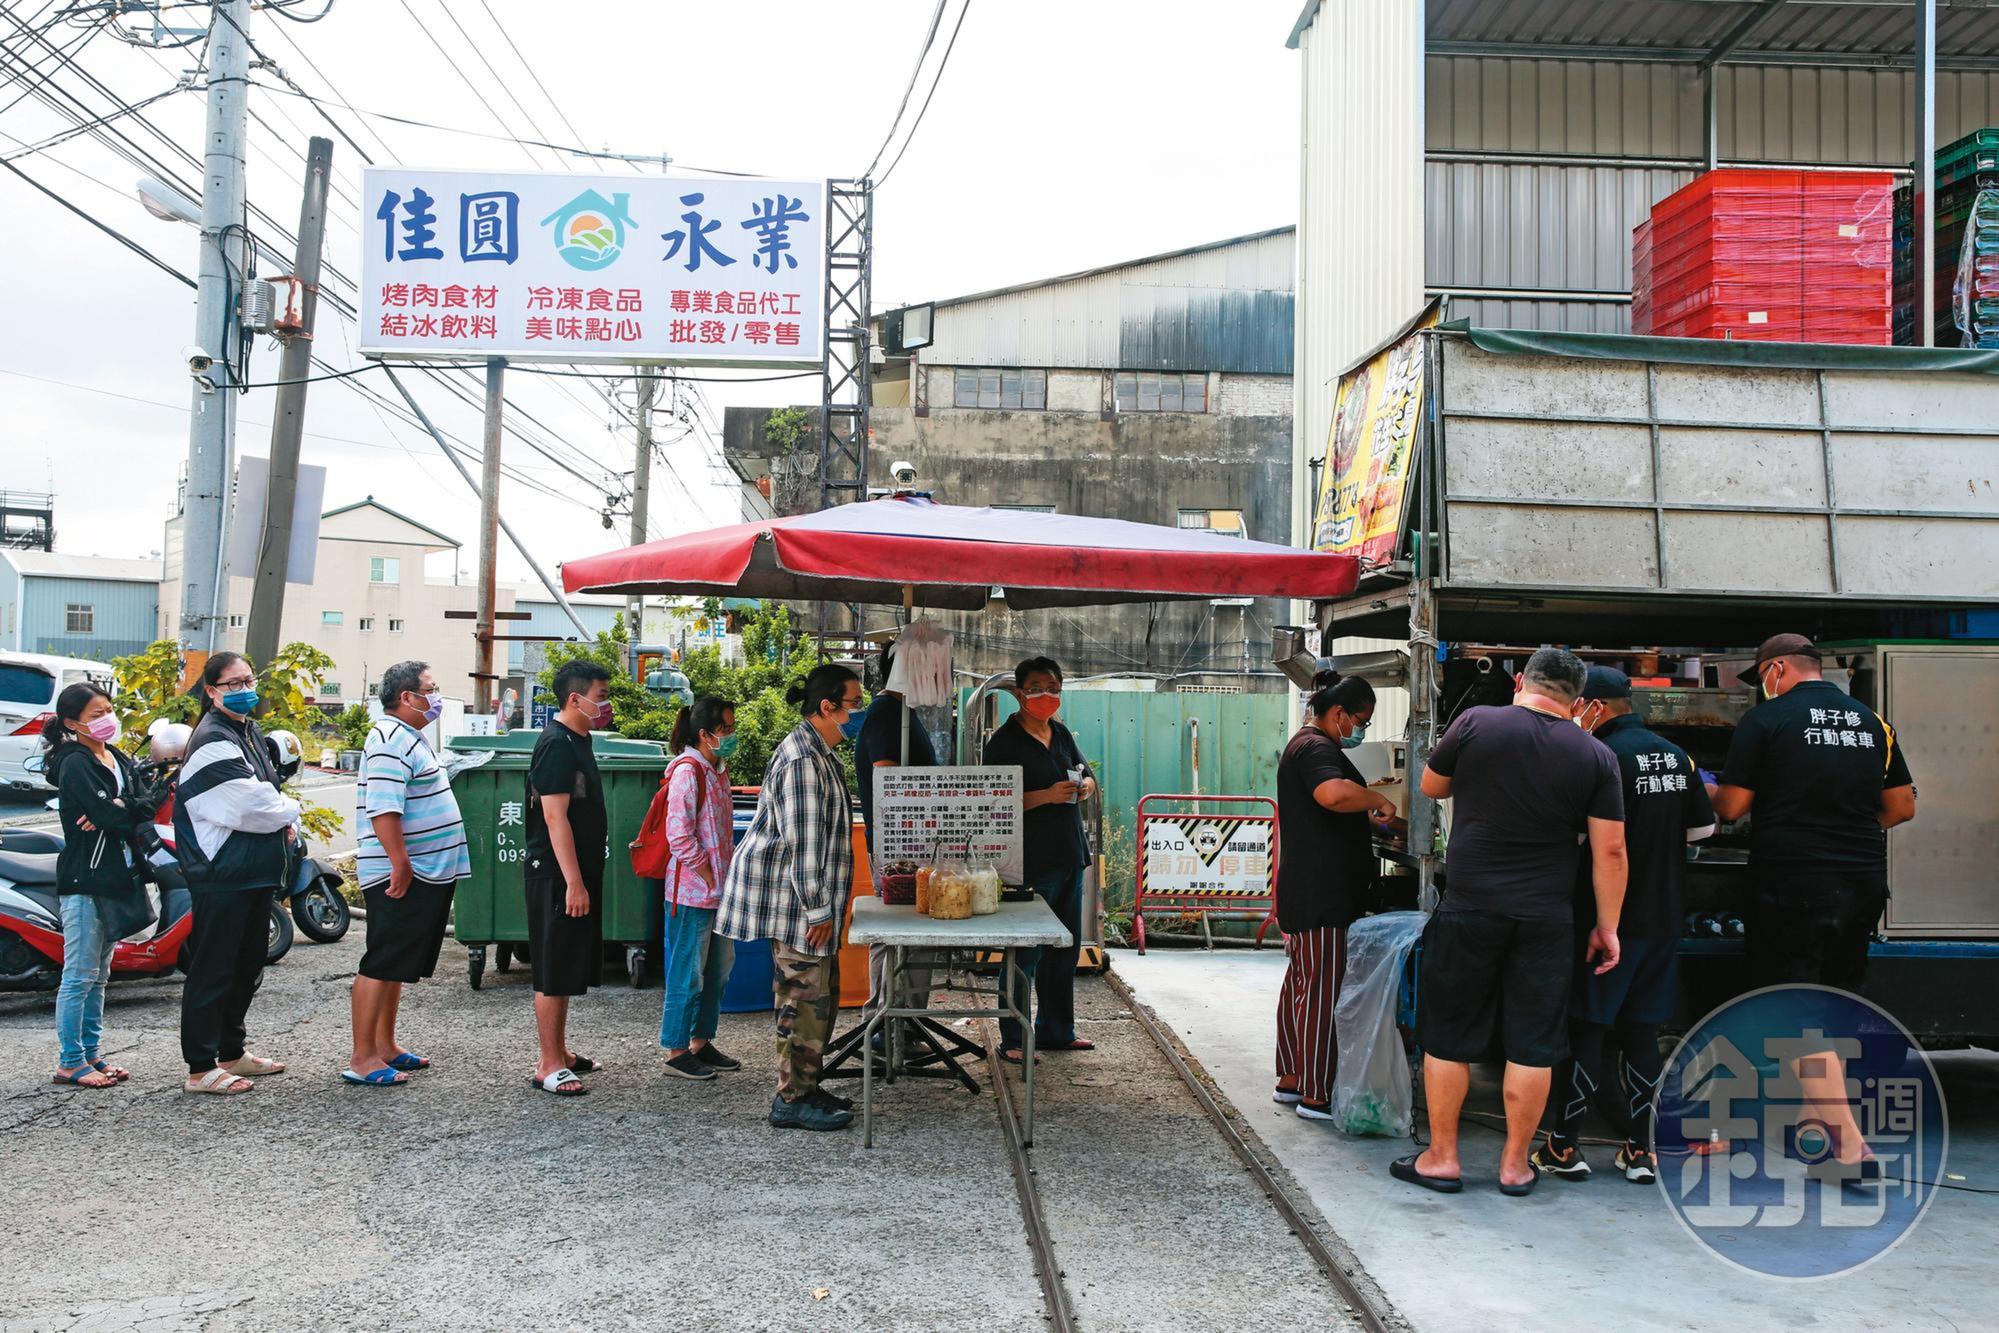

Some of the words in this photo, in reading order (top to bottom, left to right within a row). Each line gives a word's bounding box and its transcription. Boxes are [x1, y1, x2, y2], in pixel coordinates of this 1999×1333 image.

[377, 187, 519, 265] 佳圓
[661, 193, 810, 274] 永業
[381, 284, 498, 309] 烤肉食材
[526, 287, 642, 312] 冷凍食品
[670, 290, 801, 315] 專業食品代工
[380, 314, 497, 339] 結冰飲料
[525, 316, 642, 341] 美味點心
[669, 320, 800, 345] 批發/零售
[1810, 708, 1861, 727] 胖子修
[1804, 727, 1875, 749] 行動餐車
[1636, 752, 1678, 772] 胖子修
[1635, 774, 1688, 794] 行動餐車
[1151, 840, 1184, 851] 出入口
[1228, 842, 1266, 852] 請留通道
[1150, 854, 1198, 875] 請勿
[1219, 855, 1266, 876] 停車
[1190, 881, 1225, 889] 謝謝合作
